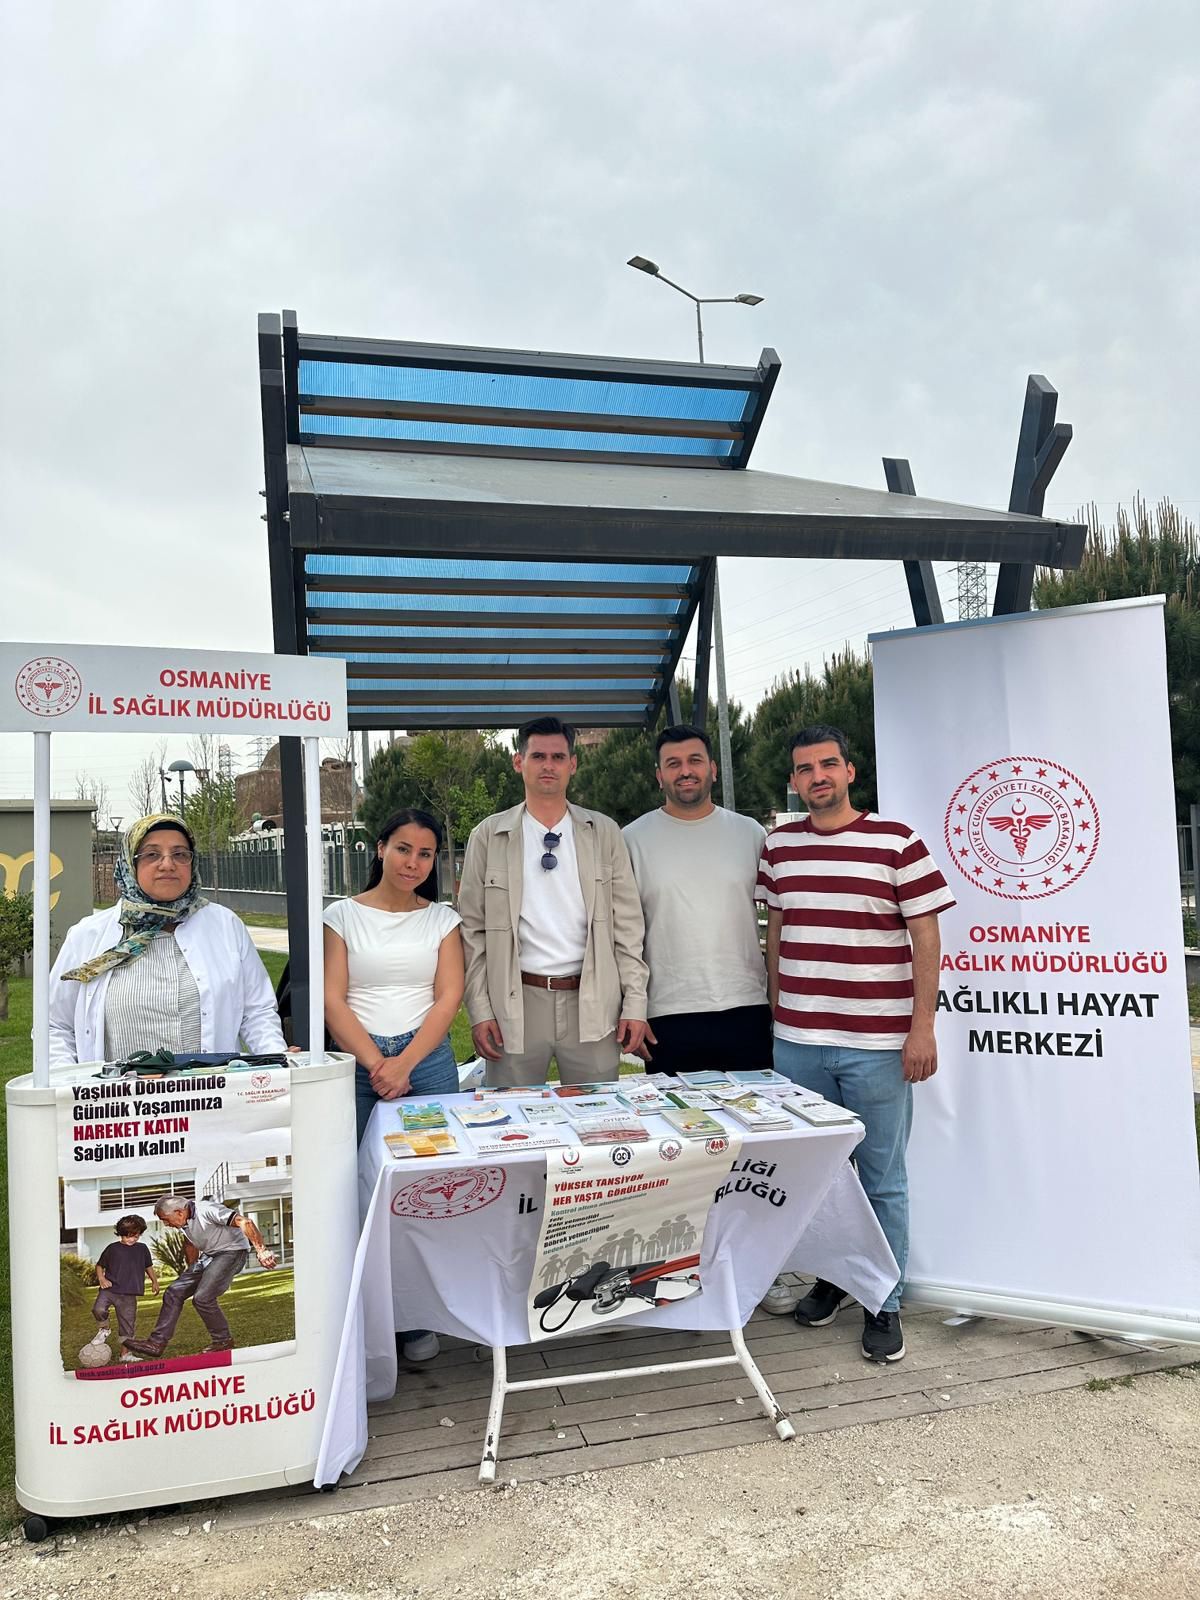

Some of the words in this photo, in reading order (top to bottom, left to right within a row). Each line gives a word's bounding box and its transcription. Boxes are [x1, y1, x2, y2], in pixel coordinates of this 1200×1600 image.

[159, 668, 272, 691] OSMANİYE
[88, 692, 107, 715] İL
[113, 694, 193, 718] SAĞLIK
[196, 697, 331, 722] MÜDÜRLÜĞÜ
[973, 783, 1027, 827] CUMHURİYETİ
[1031, 785, 1064, 811] SAĞLIK
[973, 831, 1000, 867] TÜRKİYE
[1044, 813, 1070, 865] BAKANLIĞI
[969, 922, 1090, 944] OSMANİYE
[940, 951, 1006, 972] AĞLIK
[1011, 951, 1168, 974] MÜDÜRLÜĞÜ
[935, 985, 1048, 1015] AĞLIKLI
[1057, 992, 1159, 1018] HAYAT
[969, 1028, 1104, 1058] MERKEZİ
[72, 1082, 132, 1103] Yaşlılık
[135, 1075, 226, 1097] Döneminde
[73, 1101, 130, 1121] Günlük
[133, 1095, 222, 1118] Yaşamınıza
[74, 1120, 141, 1141] HAREKET
[144, 1117, 189, 1136] KATIN
[74, 1140, 135, 1162] Sağlıklı
[138, 1137, 185, 1157] Kalın!
[730, 1158, 777, 1177] LİĞİ
[552, 1195, 572, 1206] HER
[574, 1191, 603, 1202] YAŞTA
[606, 1178, 669, 1197] GÖRÜLEBİLİR!
[554, 1179, 594, 1192] YÜKSEK
[595, 1173, 644, 1187] TANSİYON
[714, 1177, 787, 1207] RLÜĞÜ
[519, 1193, 538, 1214] İL
[120, 1374, 246, 1409] OSMANİYE
[50, 1422, 67, 1445] İL
[73, 1418, 158, 1445] SAĞLIK
[164, 1388, 316, 1434] MÜDÜRLÜĞÜ
